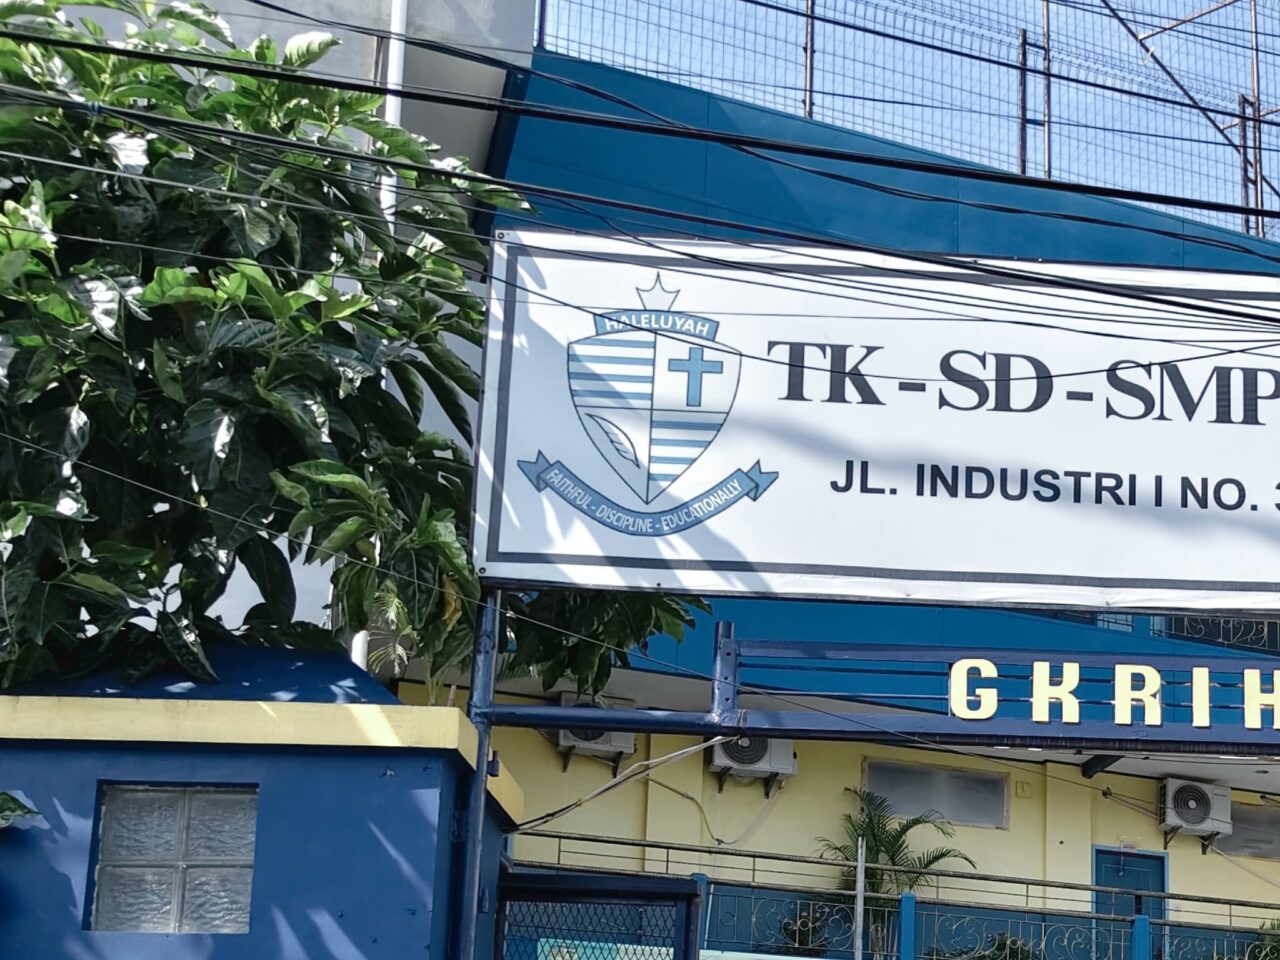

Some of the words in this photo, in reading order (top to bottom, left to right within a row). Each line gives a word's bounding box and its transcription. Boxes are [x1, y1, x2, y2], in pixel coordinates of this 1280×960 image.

[604, 313, 710, 337] HALELUYAH
[545, 467, 591, 511] FAITHFUL
[595, 503, 654, 533] DISCIPLINE
[660, 478, 743, 530] EDUCATIONALLY
[830, 459, 897, 495] JL.
[916, 463, 1137, 507] INDUSTRI
[1180, 476, 1258, 512] NO.
